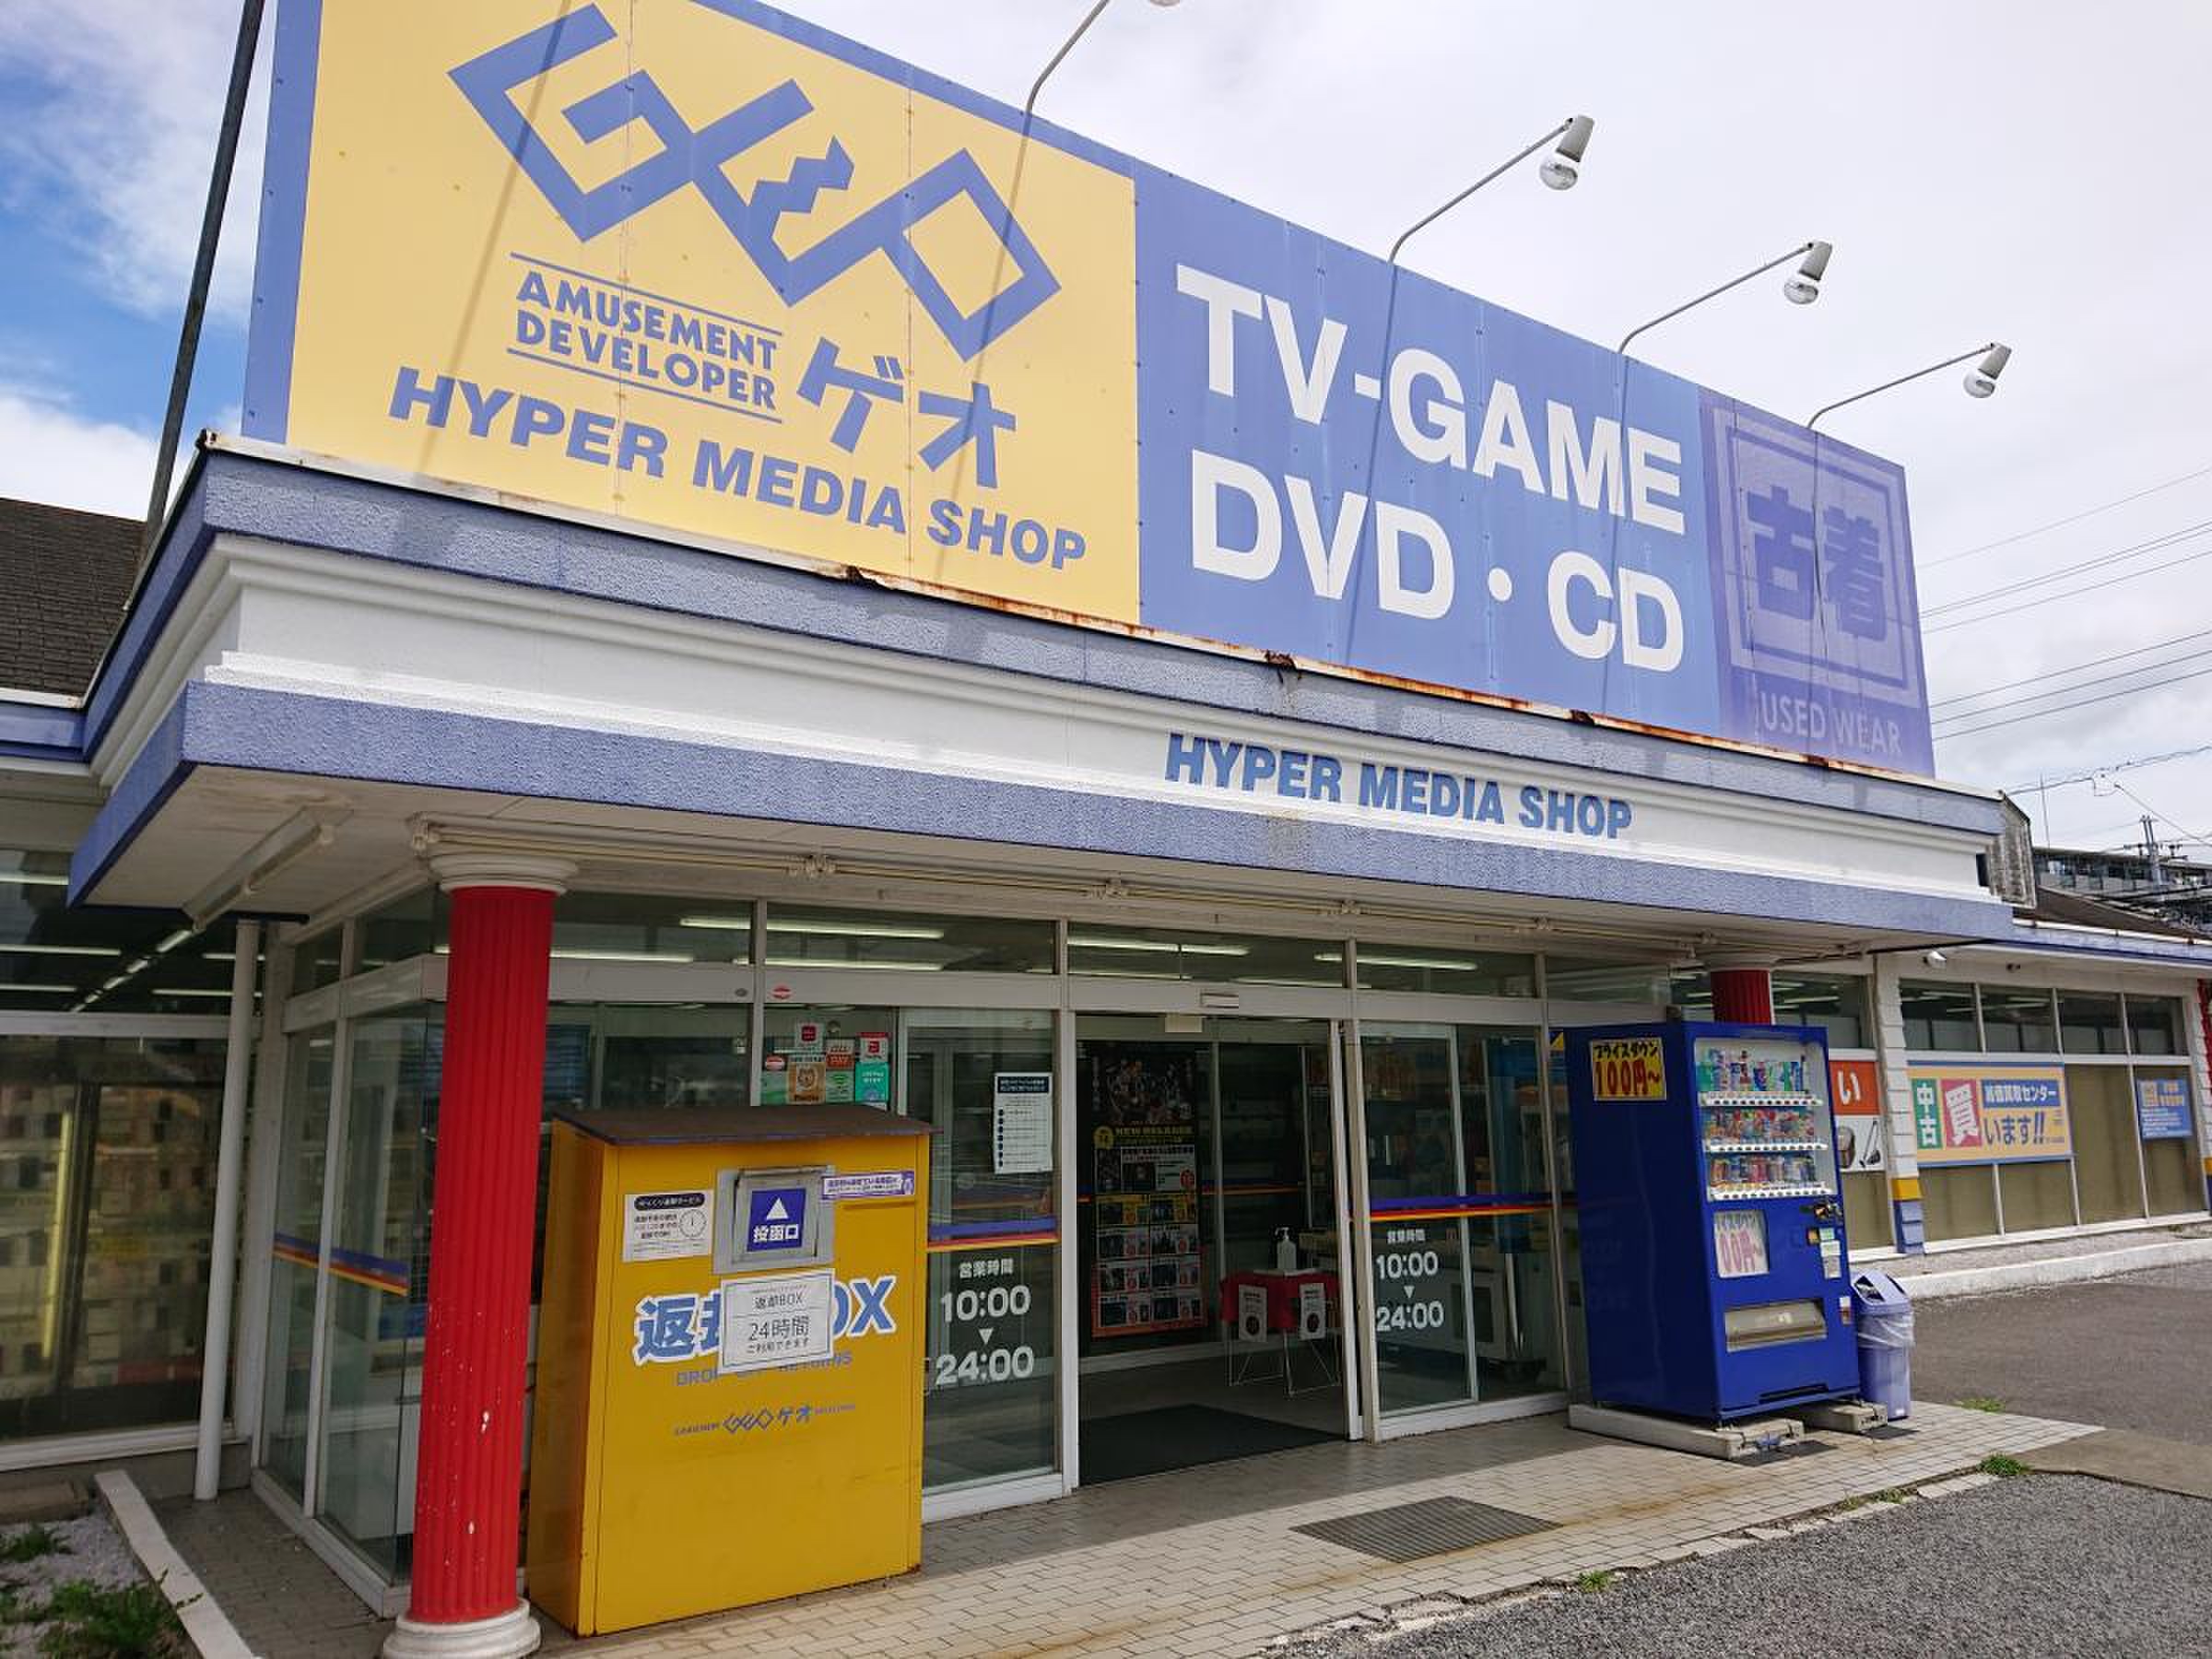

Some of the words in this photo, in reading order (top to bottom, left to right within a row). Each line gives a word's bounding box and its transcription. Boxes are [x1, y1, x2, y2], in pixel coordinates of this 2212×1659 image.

[516, 271, 777, 371] AMUSEMENT
[516, 310, 776, 410] DEVELOPER
[796, 336, 1017, 488] ゲオ
[1176, 264, 1685, 535] TV-GAME
[389, 366, 668, 477] HYPER
[692, 439, 906, 535] MEDIA
[927, 498, 1087, 571] SHOP
[1192, 449, 1456, 620] DVD
[1547, 551, 1685, 672] CD
[1746, 485, 1887, 642] 古着
[1761, 689, 1826, 740] USED
[1829, 707, 1902, 755] WEAR
[1165, 734, 1342, 803] HYPER
[1358, 762, 1505, 825] MEDIA
[1518, 785, 1633, 840] SHOP
[1916, 1082, 1938, 1147] 中古
[752, 1223, 799, 1243] 投函口
[1376, 1252, 1439, 1280] 10:00
[959, 1258, 1014, 1279] 営業時間
[748, 1315, 810, 1342] 24時間
[941, 1285, 1032, 1323] 10:00
[1376, 1300, 1444, 1332] 24:00
[935, 1346, 1035, 1386] 24:00
